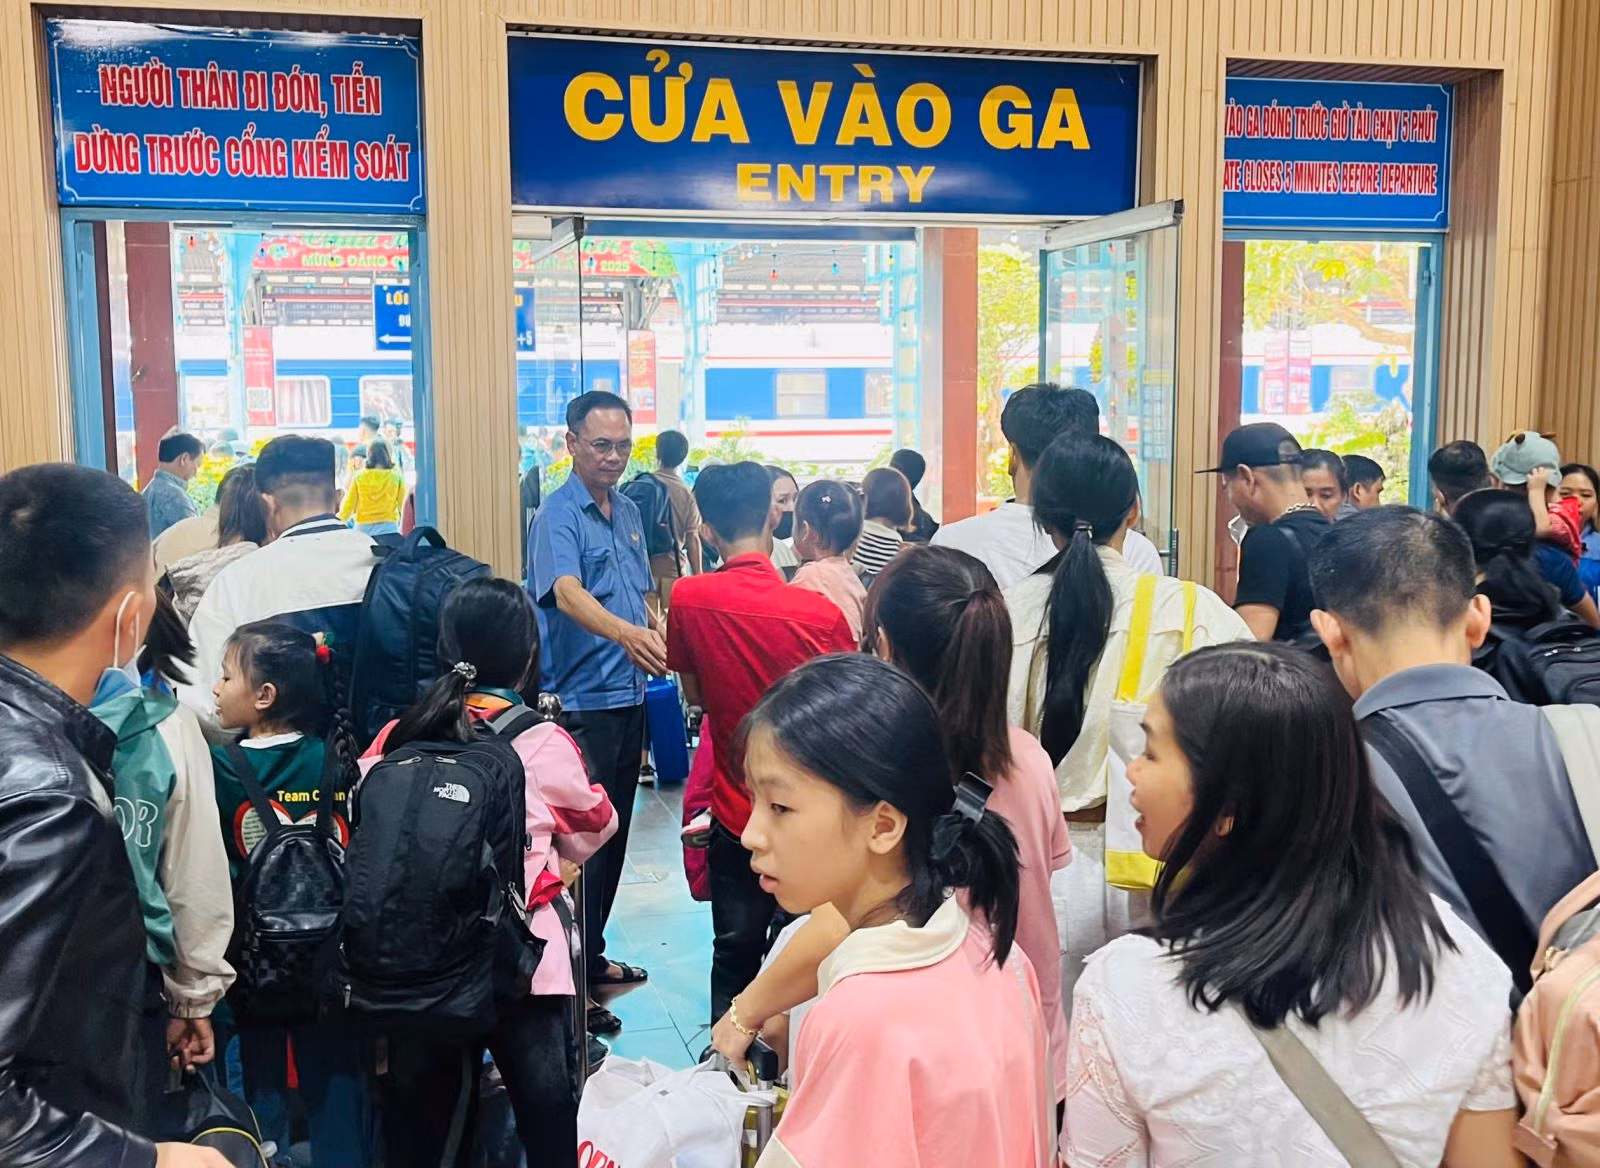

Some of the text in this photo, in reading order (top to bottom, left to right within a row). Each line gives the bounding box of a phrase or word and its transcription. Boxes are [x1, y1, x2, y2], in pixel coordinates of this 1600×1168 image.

[98, 57, 382, 119] NGƯỜI THÂN ĐI ĐÓN, TIỄN
[564, 49, 1091, 150] CỬA VÀO GA
[1245, 105, 1260, 138] GA
[1261, 99, 1292, 139] ĐÓNG
[1293, 100, 1328, 140] TRƯỚC
[1329, 100, 1350, 141] GIỜ
[1350, 102, 1371, 141] TÀU
[1371, 109, 1400, 149] CHẠY
[1400, 110, 1409, 142] 5
[1409, 104, 1438, 143] PHÚT
[73, 122, 411, 182] DỪNG TRƯỚC CỔNG KIỂM SOÁT
[736, 163, 936, 203] ENTRY
[1223, 159, 1438, 196] ATE CLOSES 5 MINUTES BEFORE DEPARTURE
[277, 790, 310, 802] Team
